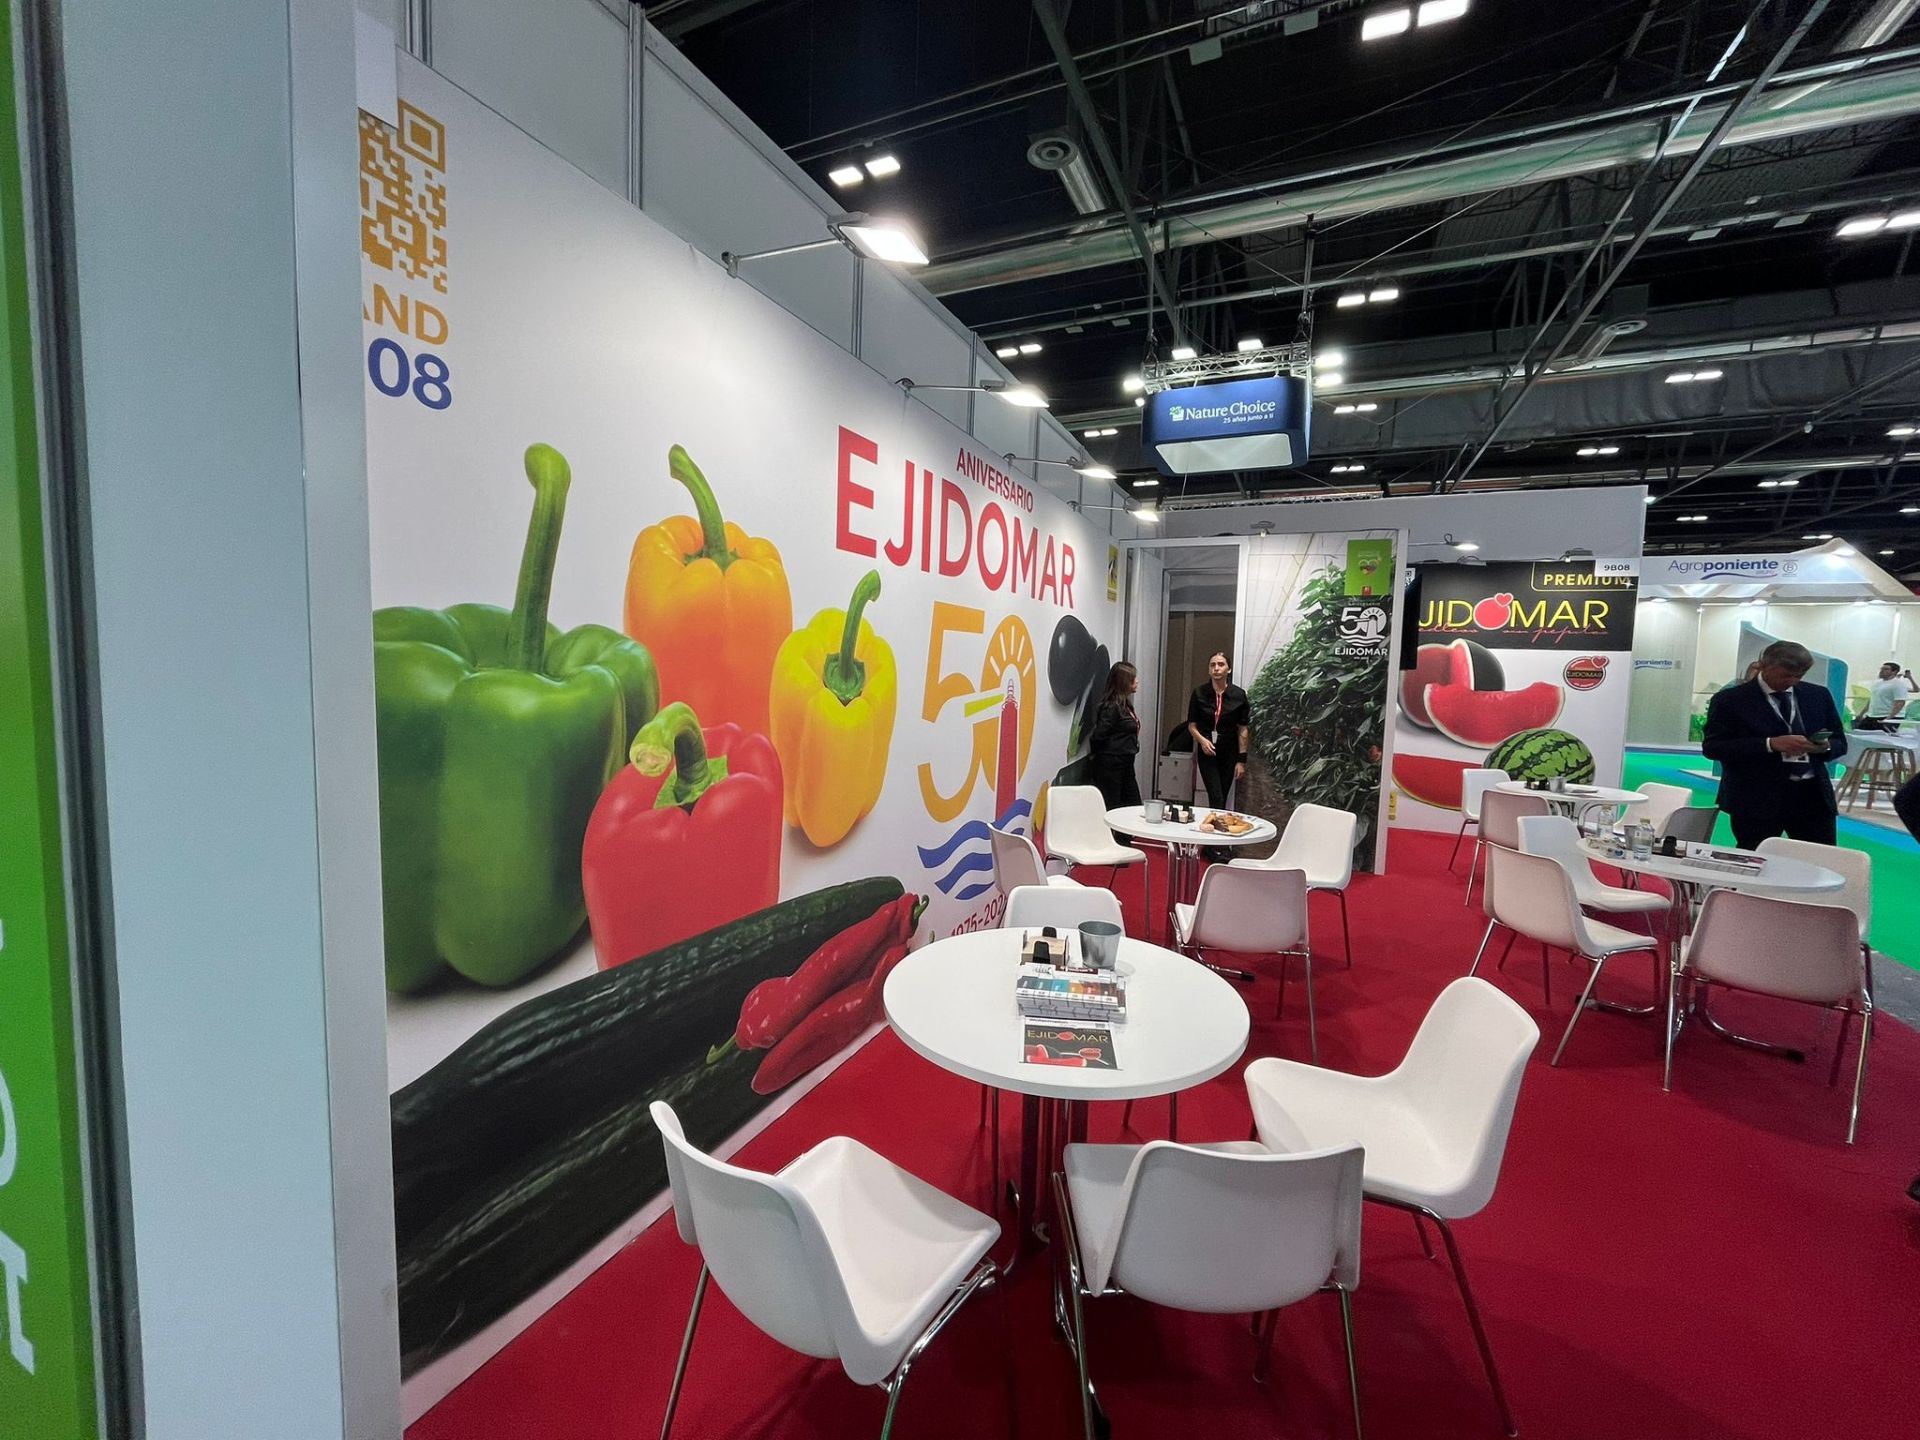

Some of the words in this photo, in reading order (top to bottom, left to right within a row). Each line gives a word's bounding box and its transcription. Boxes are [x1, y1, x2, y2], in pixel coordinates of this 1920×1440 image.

[1186, 407, 1228, 420] Nature
[1229, 400, 1276, 415] Choice
[1247, 413, 1263, 422] junto
[956, 448, 1034, 513] ANIVERSARIO
[836, 425, 1076, 609] EJIDOMAR
[1668, 559, 1779, 574] Agroponiente
[1335, 647, 1388, 656] EJIDOMAR
[917, 600, 1037, 823] 50
[1027, 1030, 1109, 1043] EJIDOMAR
